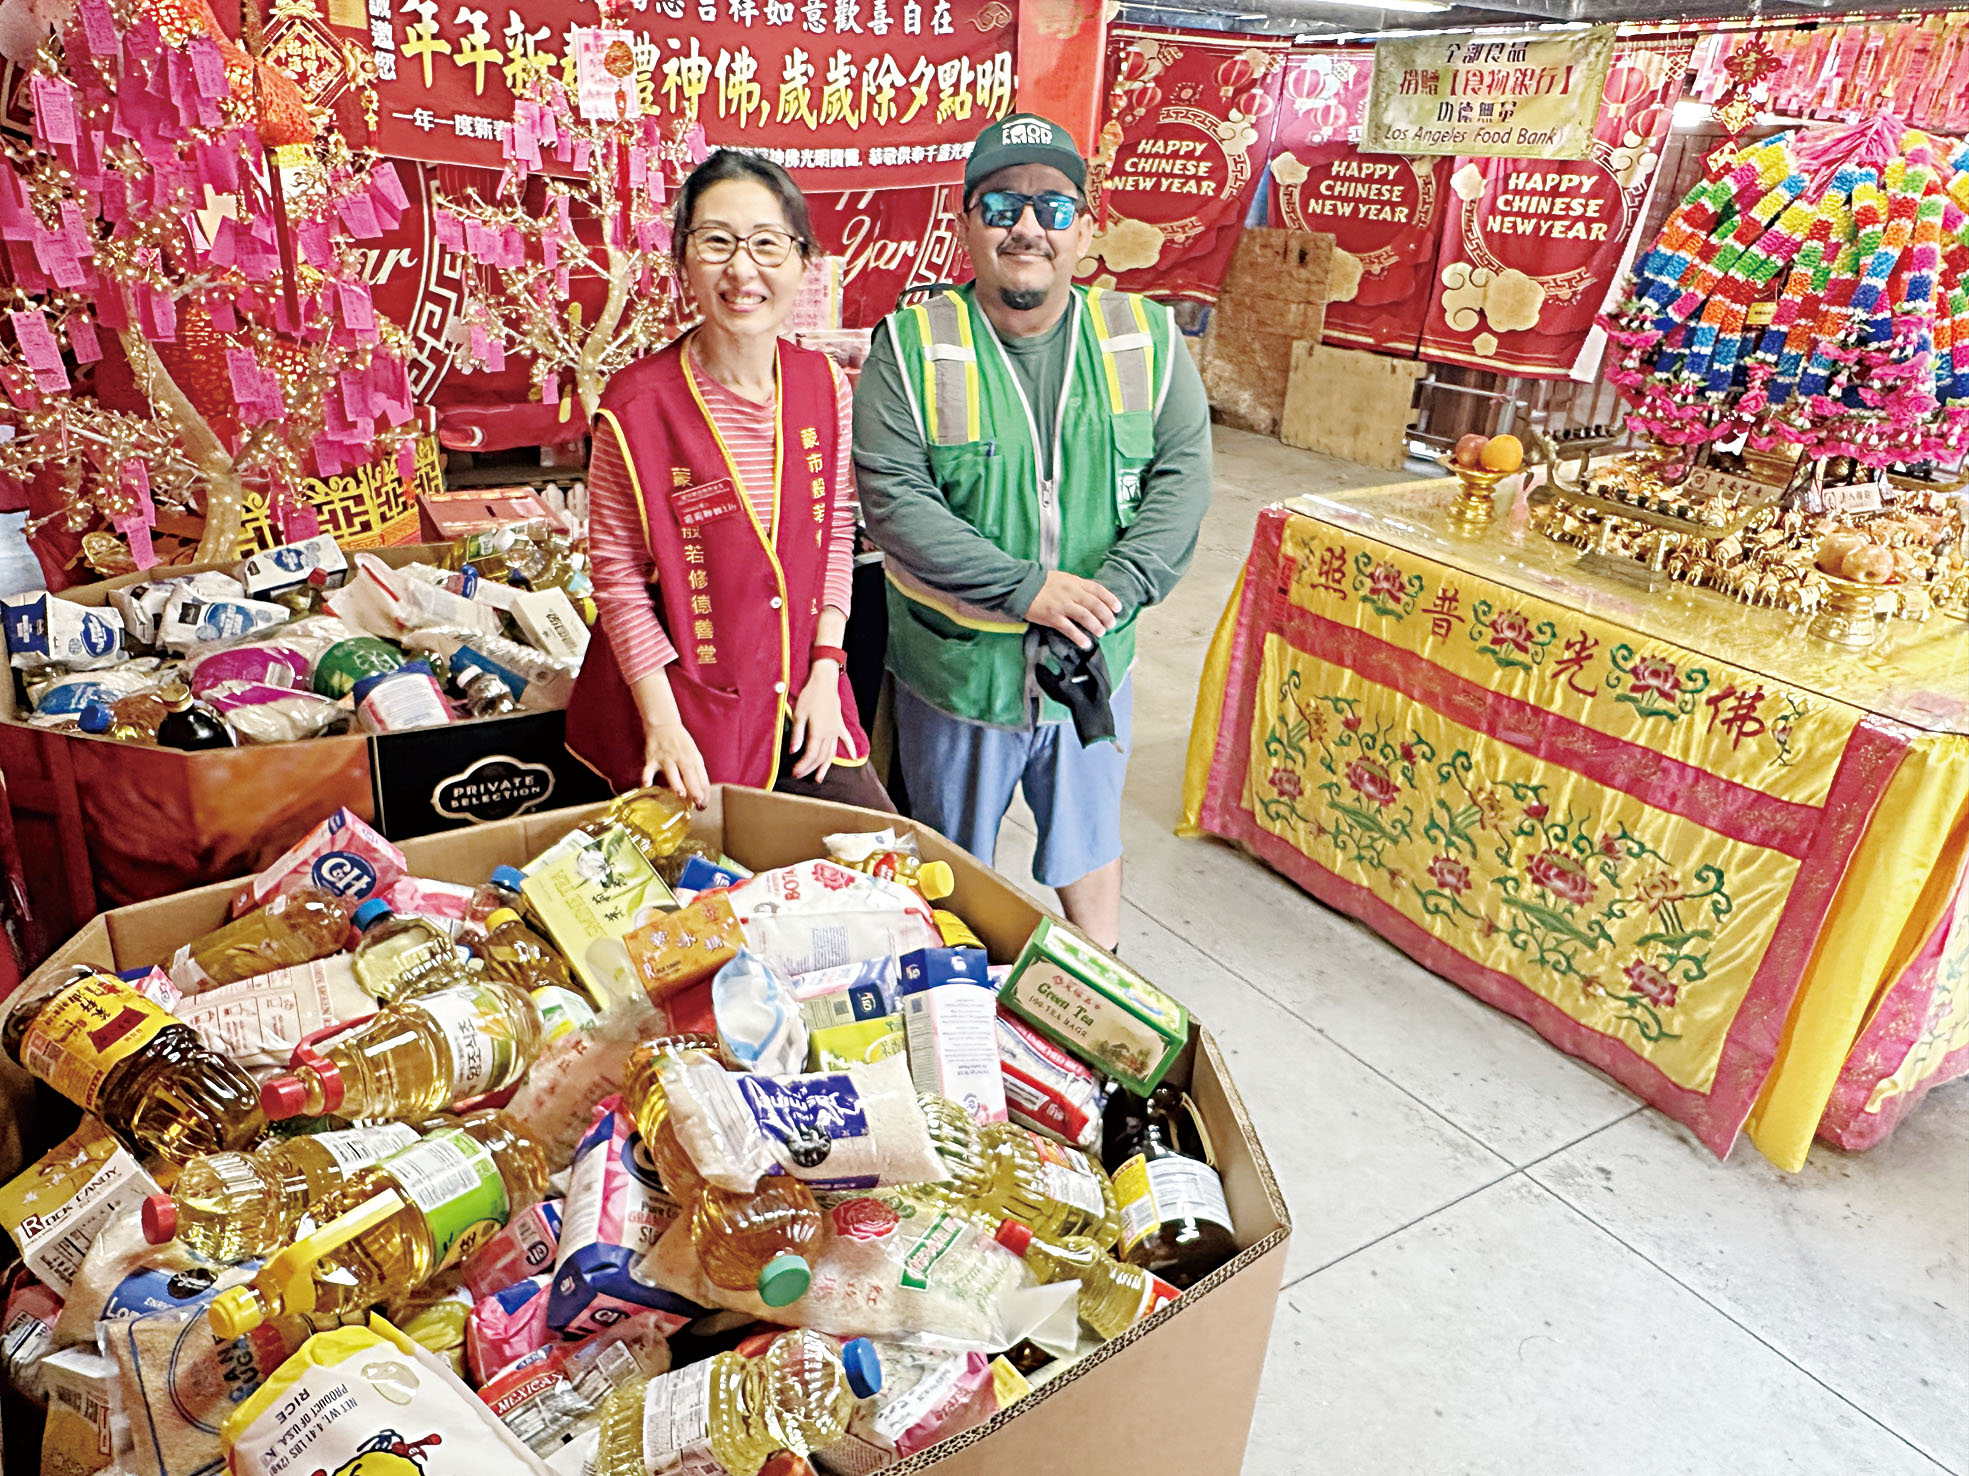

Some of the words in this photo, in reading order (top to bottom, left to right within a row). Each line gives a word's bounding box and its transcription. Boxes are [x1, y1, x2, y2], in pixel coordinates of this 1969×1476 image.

[1137, 138, 1208, 156] HAPPY
[1384, 126, 1409, 142] Los
[1413, 126, 1468, 146] Angeles
[1473, 127, 1514, 145] Food
[1124, 157, 1213, 177] CHINESE
[1330, 160, 1400, 181] HAPPY
[1112, 174, 1156, 194] NEW
[1156, 177, 1217, 197] YEAR
[1319, 180, 1406, 203] CHINESE
[1507, 172, 1601, 194] HAPPY
[1308, 199, 1351, 217] NEW
[1352, 201, 1409, 223] YEAR
[1496, 194, 1605, 217] CHINESE
[1486, 215, 1545, 236] NEW
[1543, 217, 1610, 242] YEAR
[450, 786, 541, 809] SELECTION
[453, 775, 535, 798] PRIVATE
[1037, 982, 1071, 1010] Green
[1071, 1005, 1095, 1027] Tea
[1044, 1004, 1062, 1022] TEA
[1063, 1018, 1089, 1039] BAGS
[20, 1205, 73, 1239] ROCK
[275, 1387, 310, 1424] RICE
[313, 1383, 348, 1418] PRODUCT
